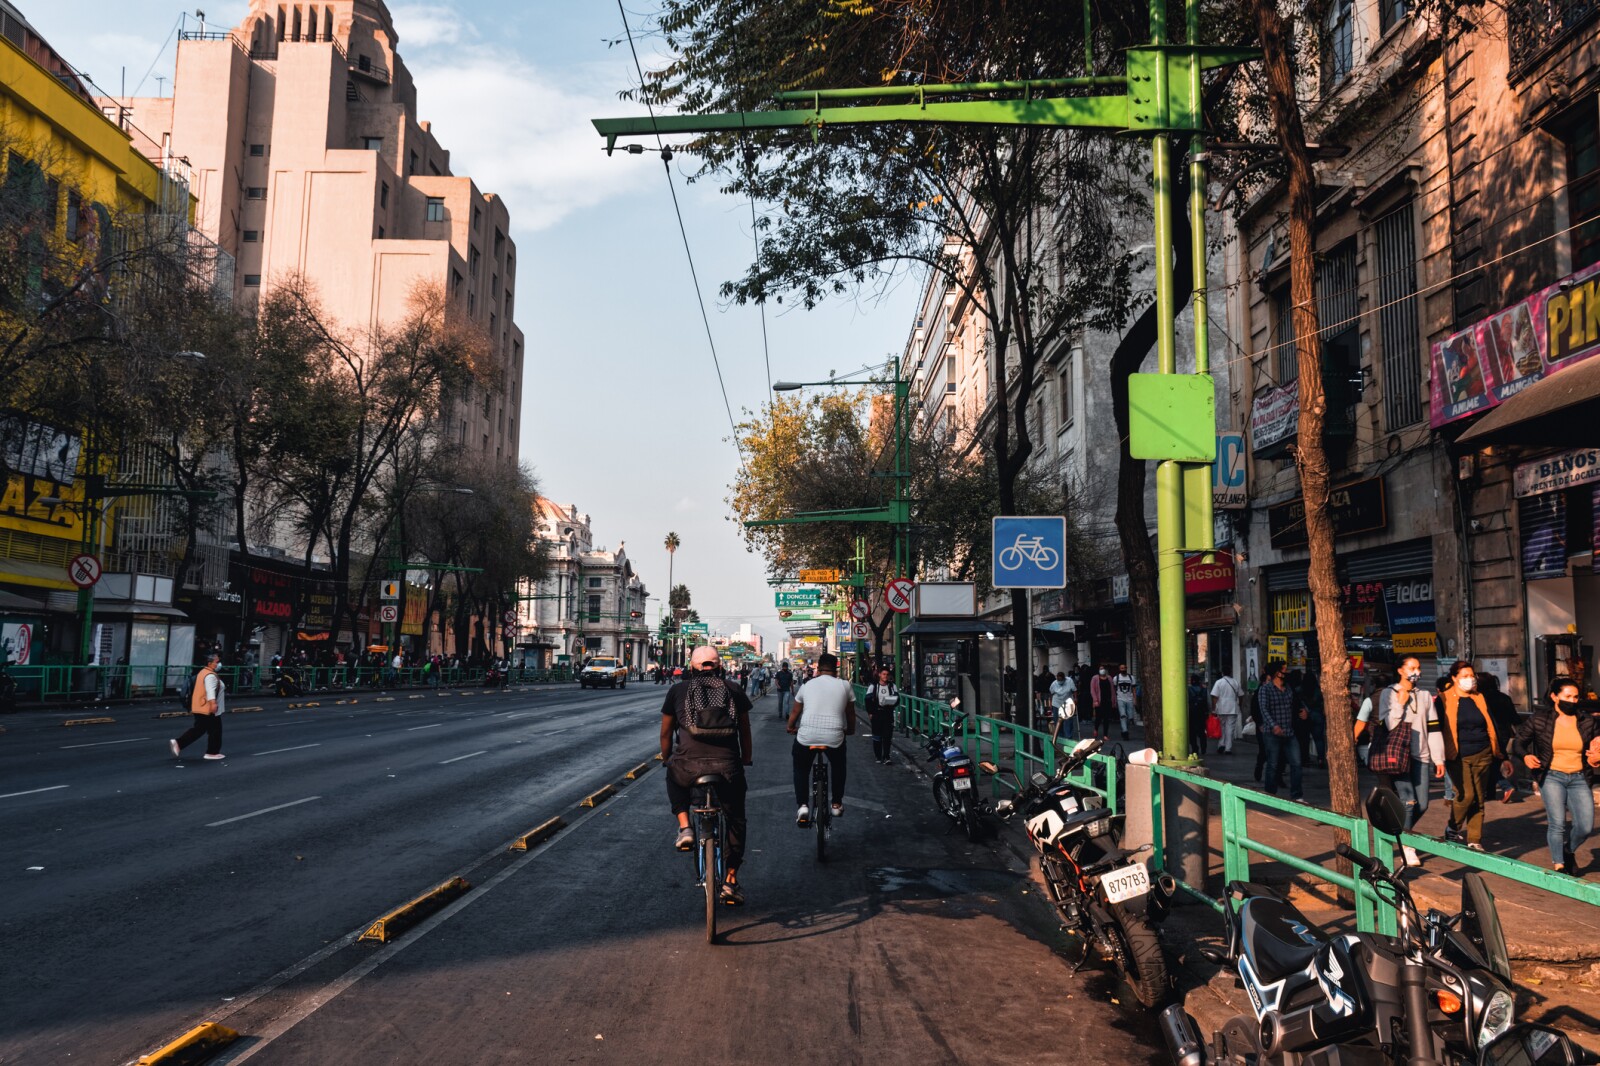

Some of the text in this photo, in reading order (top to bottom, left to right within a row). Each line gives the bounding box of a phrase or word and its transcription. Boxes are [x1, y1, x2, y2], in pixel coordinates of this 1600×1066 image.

[1451, 397, 1480, 416] ANIME
[1212, 435, 1246, 487] C
[1540, 450, 1597, 478] BAÑOS
[1533, 479, 1558, 491] RENTA
[1559, 475, 1569, 484] DE
[1396, 579, 1433, 604] telcel
[1394, 637, 1428, 648] CELULARES
[1108, 872, 1147, 894] 8797B3
